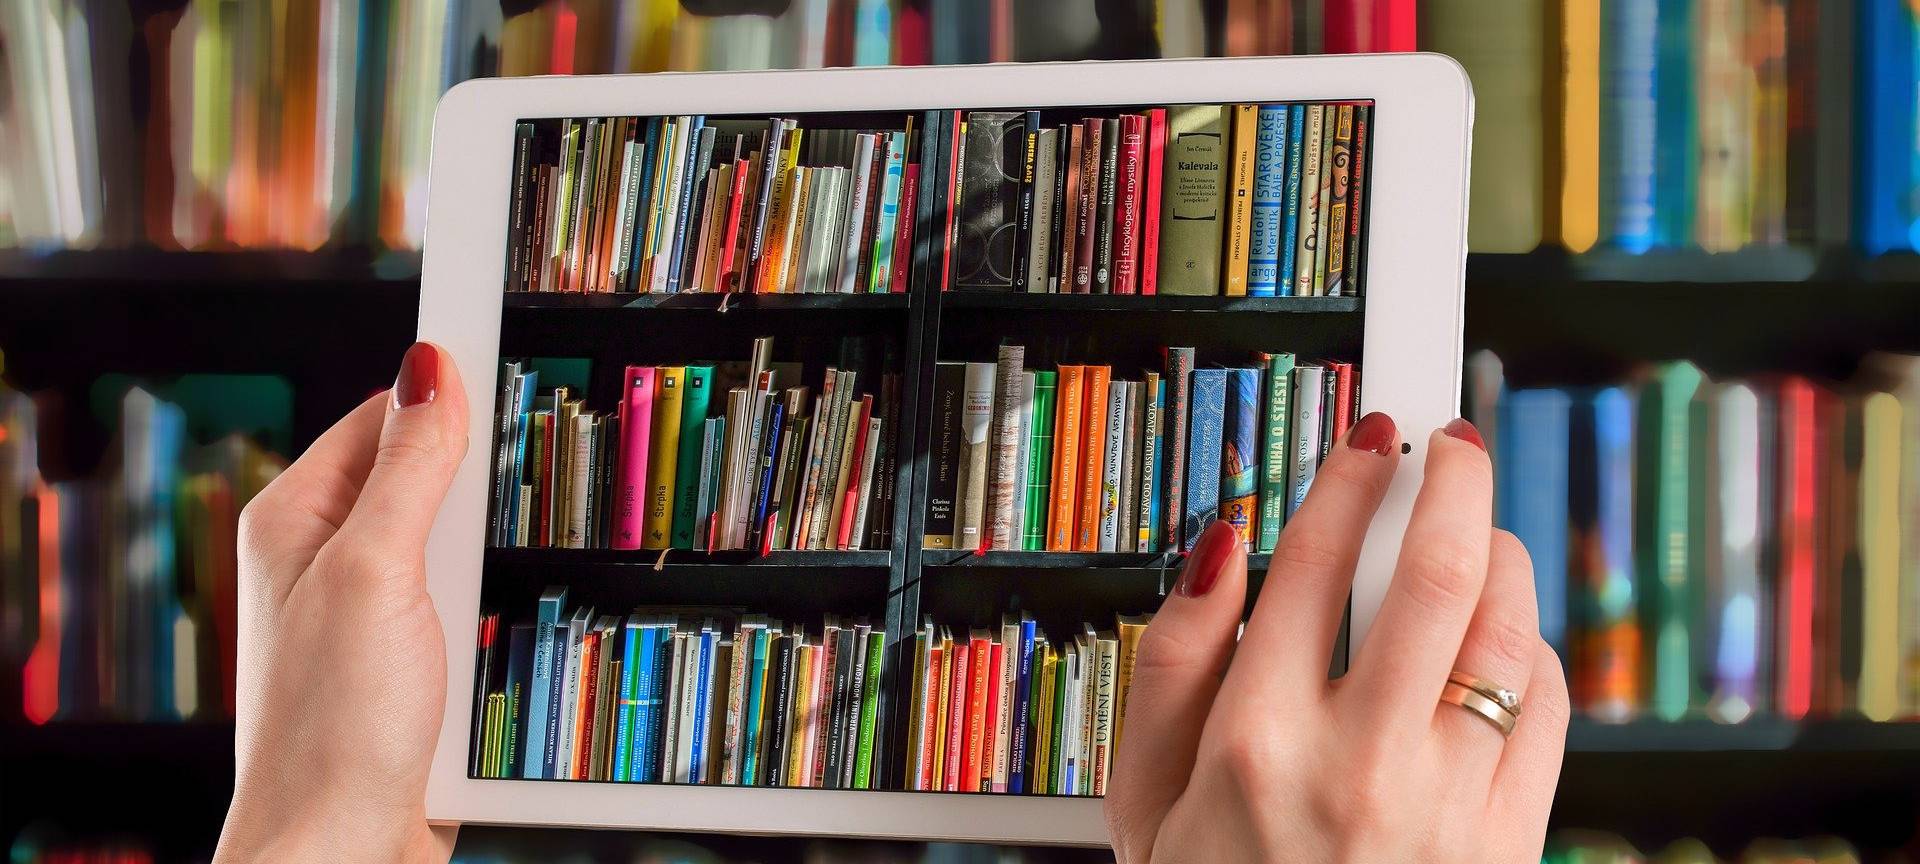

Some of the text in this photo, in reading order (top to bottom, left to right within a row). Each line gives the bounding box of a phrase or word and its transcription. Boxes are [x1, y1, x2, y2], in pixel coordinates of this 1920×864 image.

[1274, 112, 1286, 157] POVĚSTI
[1178, 161, 1218, 171] Kalevala
[1255, 112, 1275, 198] STAROVĚKÉ
[769, 156, 788, 220] SMRT MILENKY
[1101, 159, 1110, 206] Encyklopedie
[1126, 157, 1137, 192] mystiky
[1272, 174, 1283, 198] BÁJE
[1079, 194, 1089, 236] Josef Kolmaš
[1122, 195, 1135, 256] Encyklopedie
[1252, 209, 1264, 256] Rudolf
[1252, 268, 1276, 282] argo
[1146, 401, 1156, 434] ŽIVOTA
[1268, 375, 1288, 484] KNIHA O ŠTĚSTÍ
[746, 466, 754, 486] IGOR
[1142, 483, 1151, 515] NÁVOD
[848, 700, 859, 731] VIRGINIA
[1094, 652, 1112, 743] UMĚNÍ VÉST
[547, 746, 555, 764] MILAN
